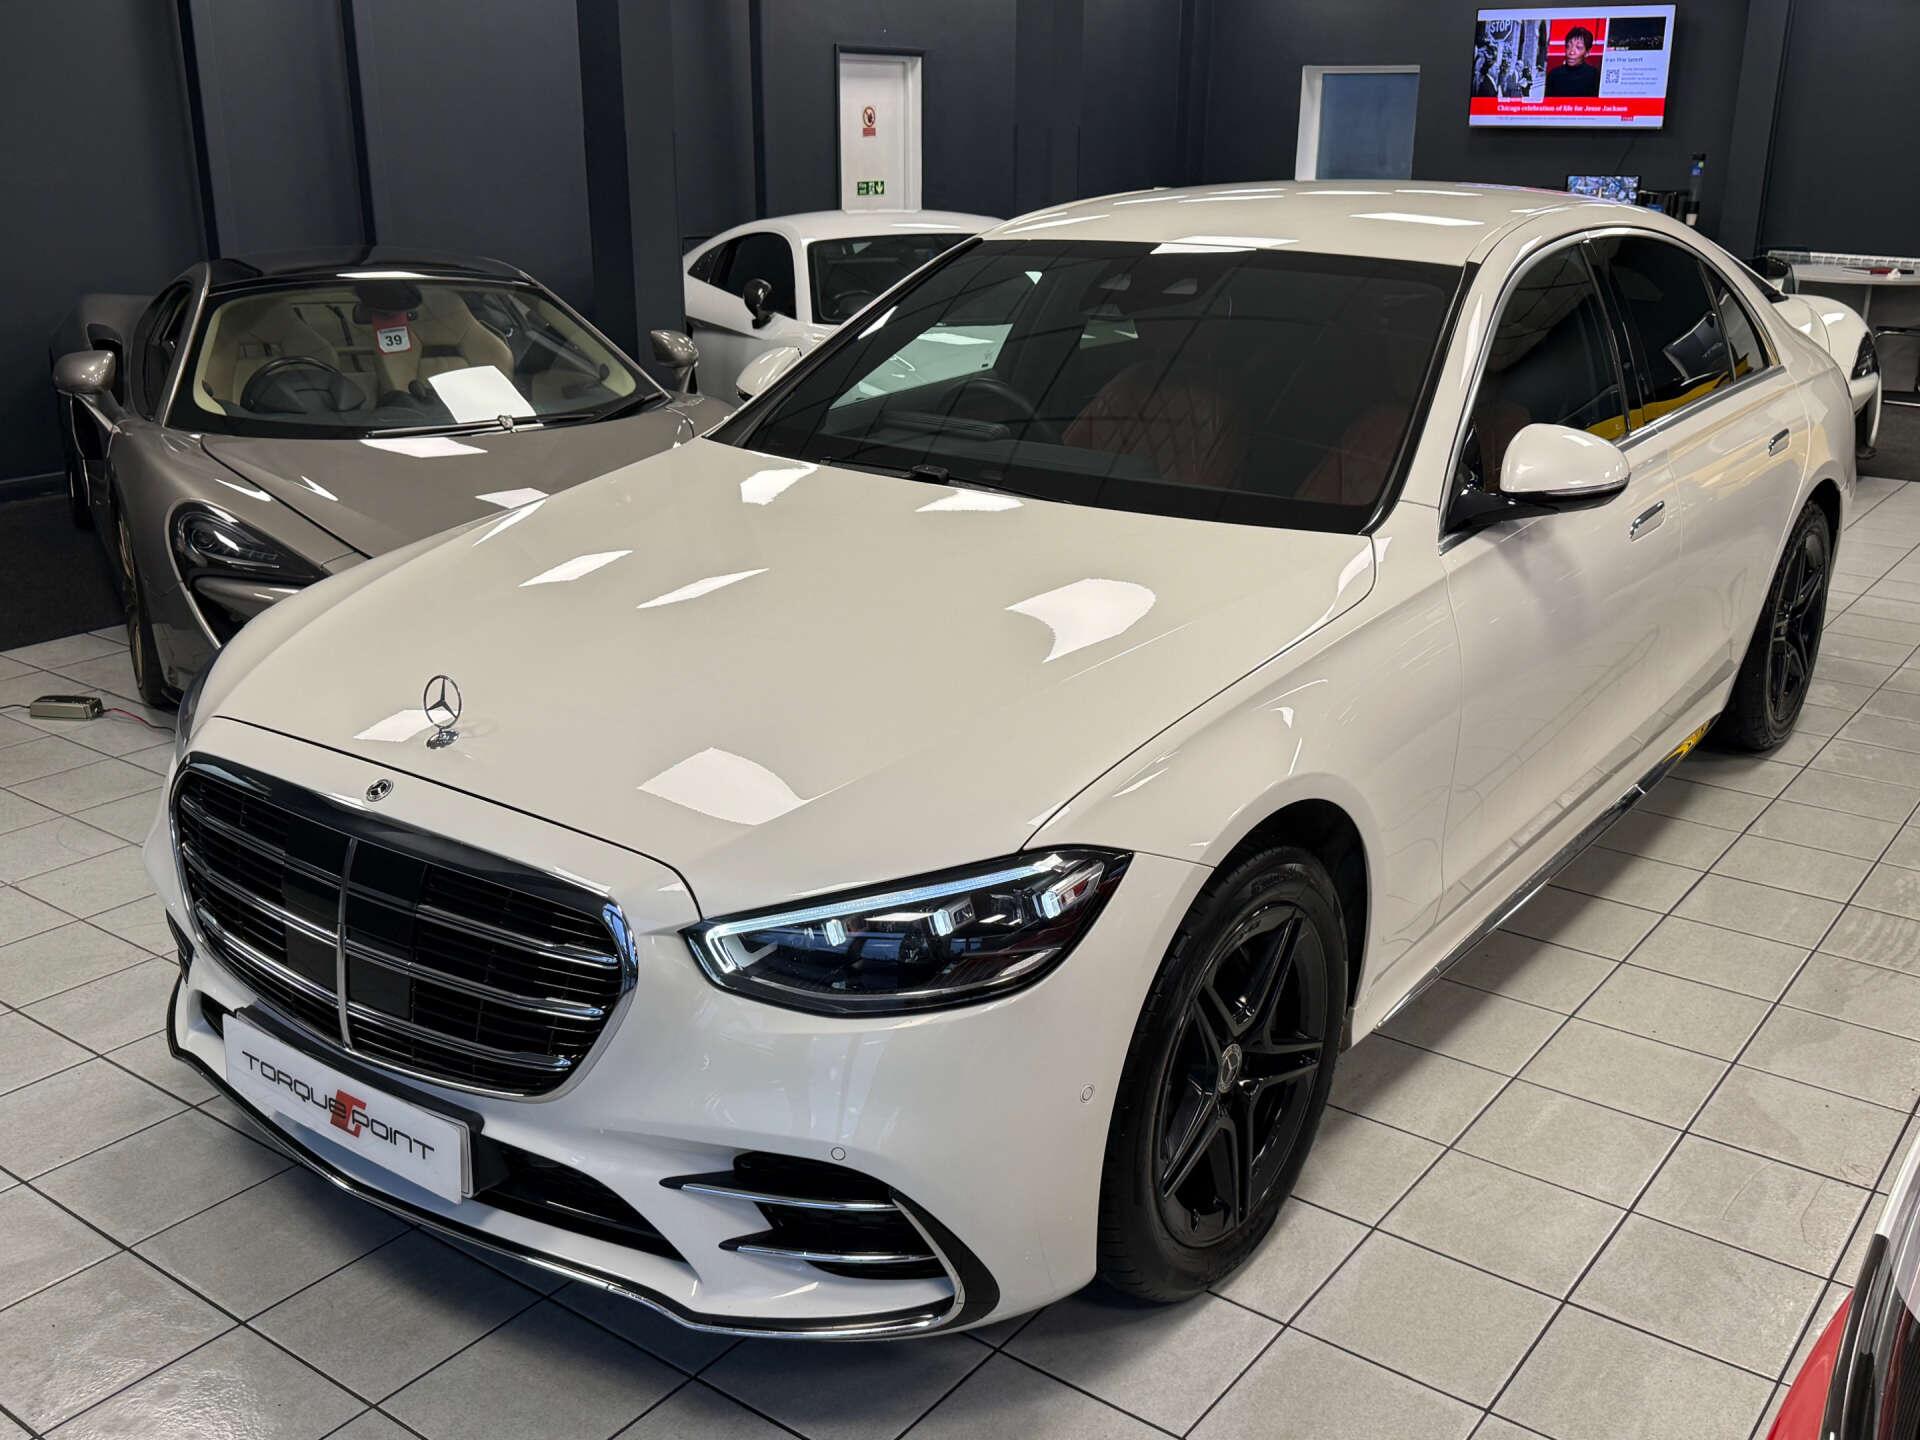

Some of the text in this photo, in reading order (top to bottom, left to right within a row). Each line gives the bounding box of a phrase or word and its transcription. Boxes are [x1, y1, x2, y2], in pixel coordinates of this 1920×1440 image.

[1490, 20, 1511, 33] STOP
[385, 334, 402, 346] 39
[242, 1050, 346, 1118] TORQUE
